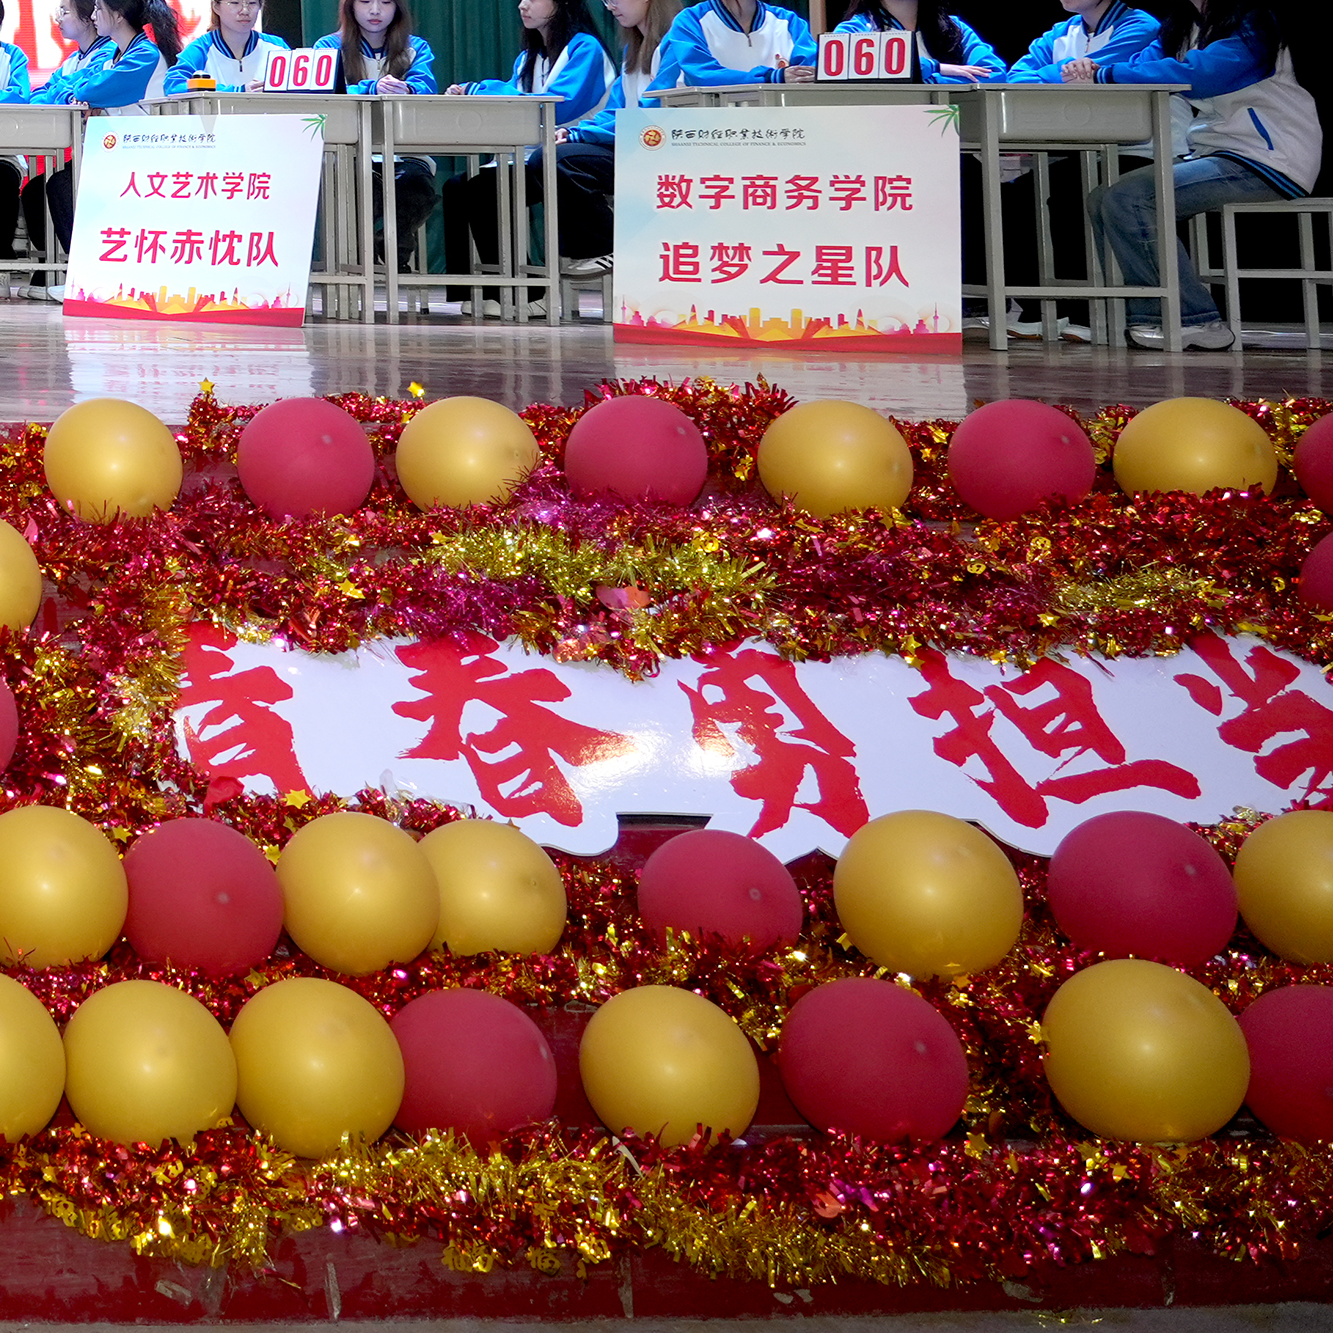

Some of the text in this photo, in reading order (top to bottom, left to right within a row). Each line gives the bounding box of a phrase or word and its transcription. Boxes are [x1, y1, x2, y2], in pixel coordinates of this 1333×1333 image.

[269, 54, 332, 88] 060
[823, 37, 906, 77] 060
[119, 171, 272, 200] 人文艺术学院
[656, 174, 913, 211] 数字商务学院
[98, 227, 279, 267] 艺怀赤忱队
[659, 241, 909, 288] 追梦之星队
